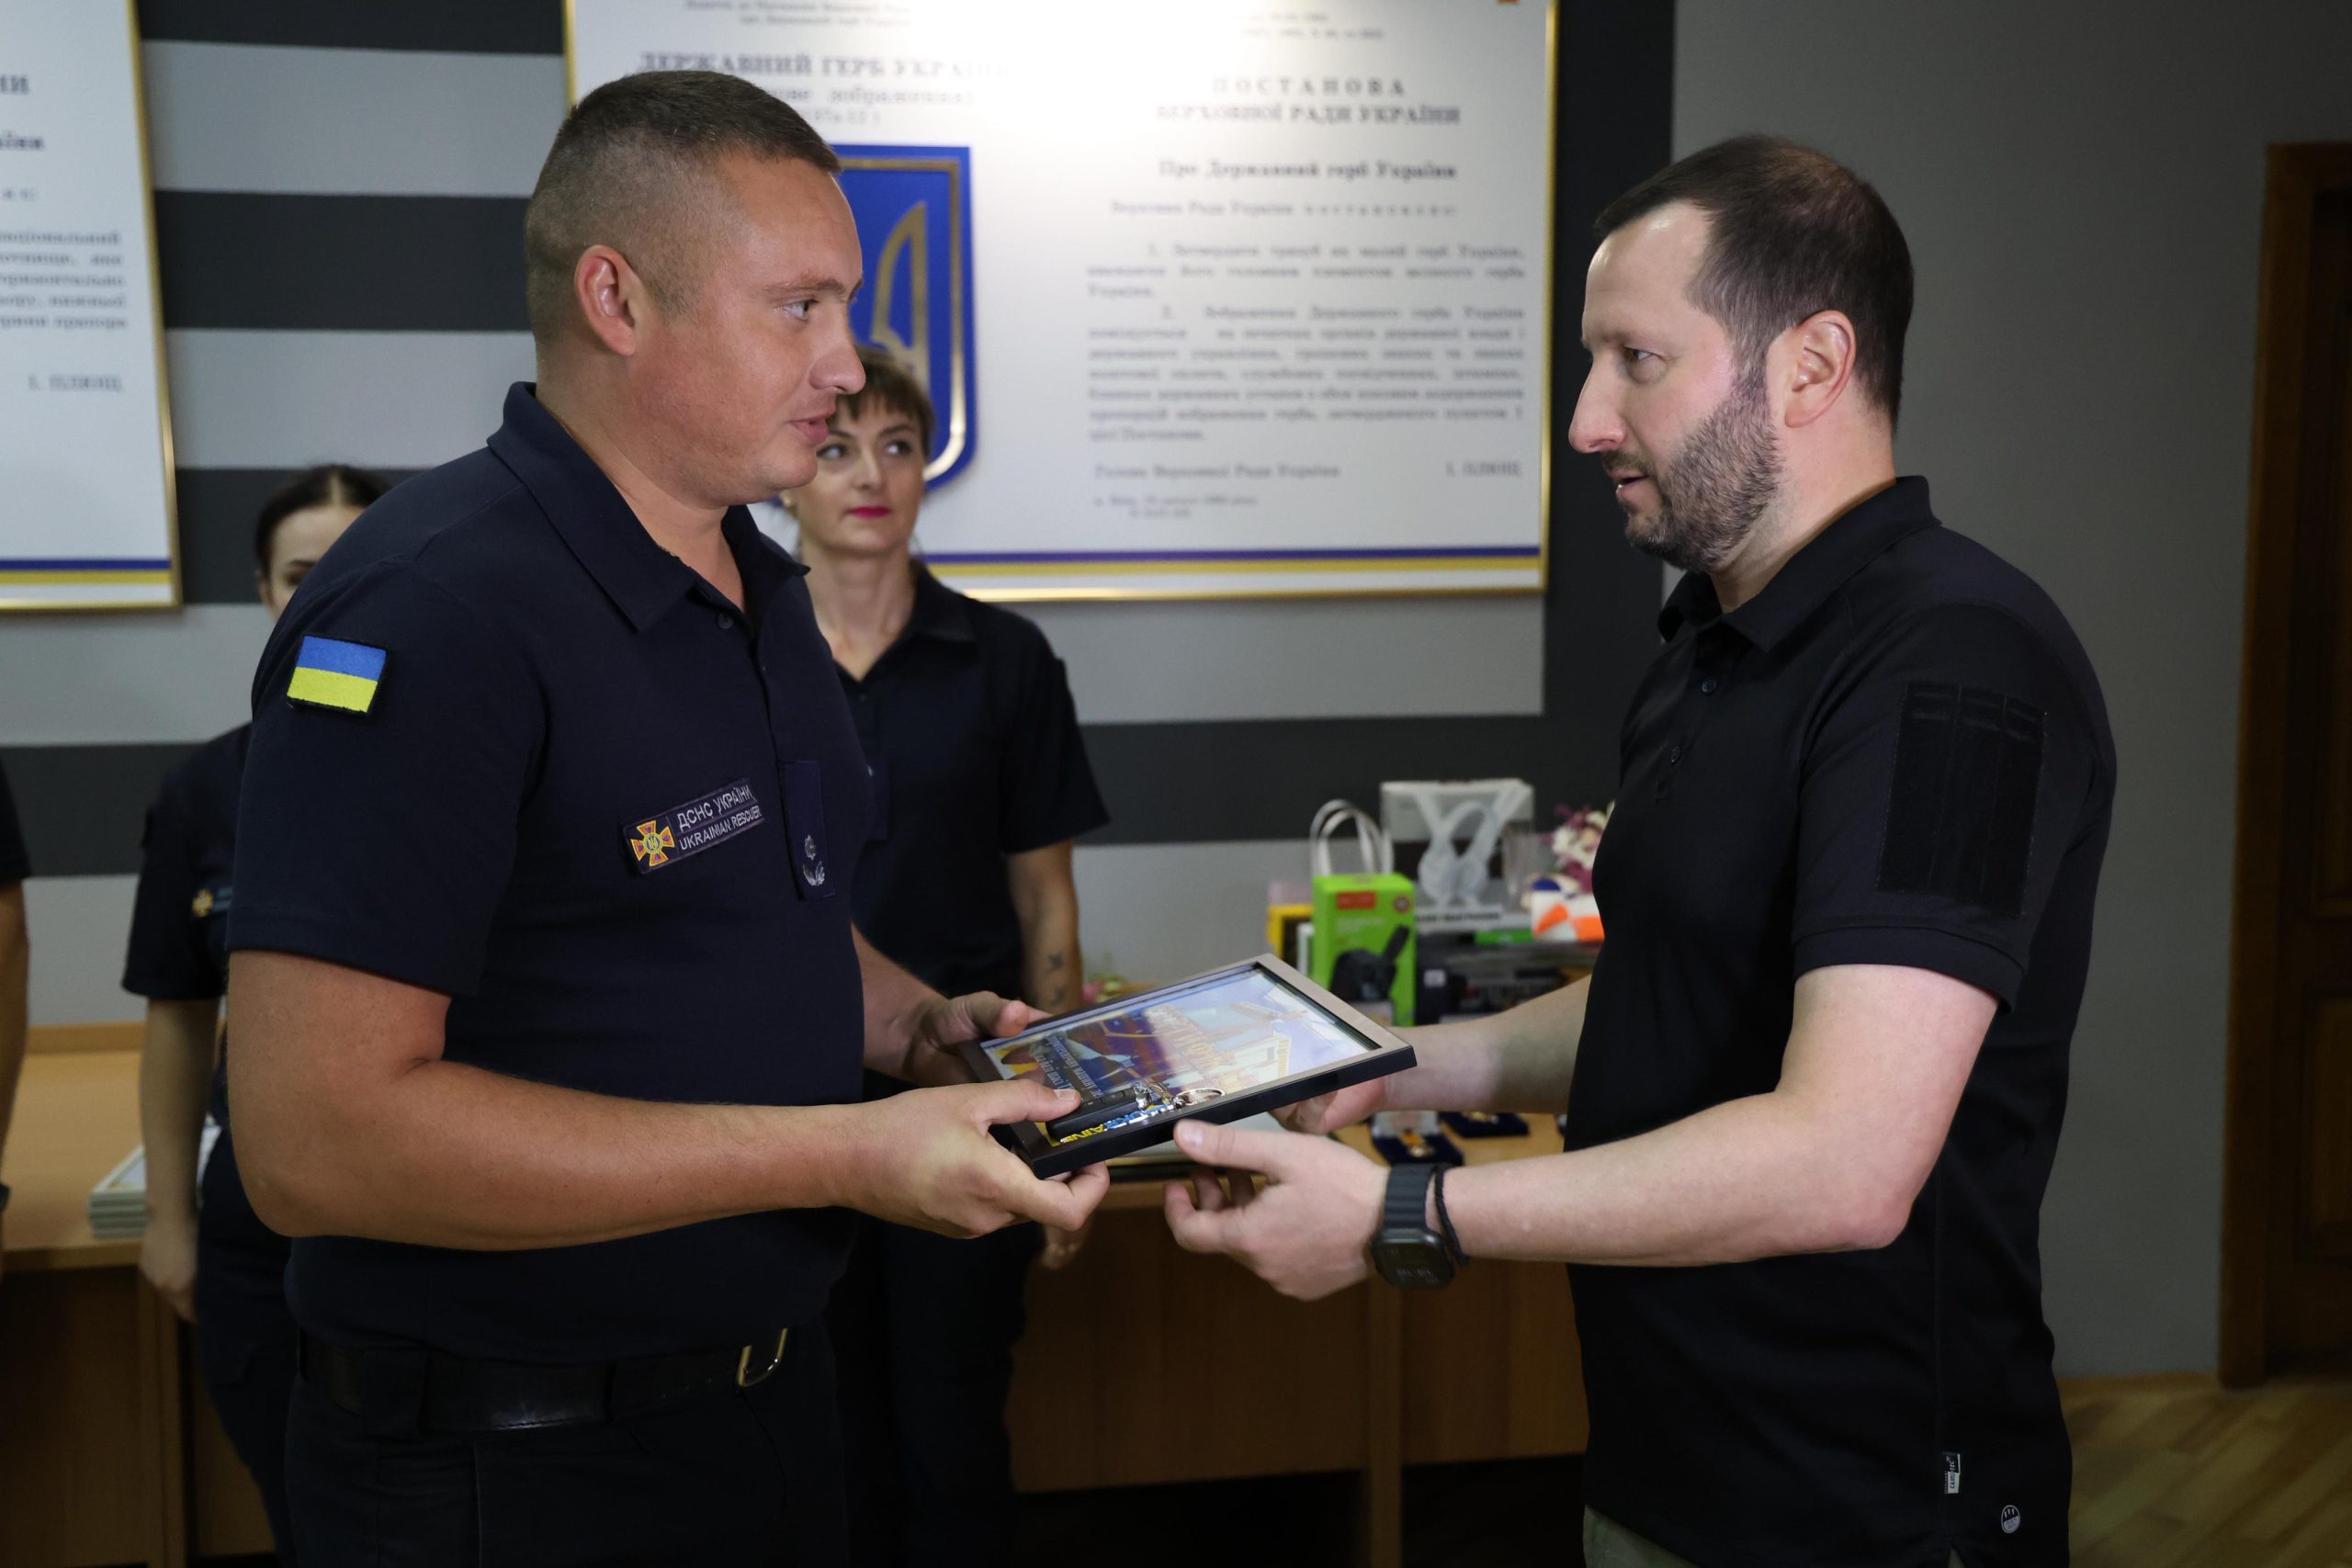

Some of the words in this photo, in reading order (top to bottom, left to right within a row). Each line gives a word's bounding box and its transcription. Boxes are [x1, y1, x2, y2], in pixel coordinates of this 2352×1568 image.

[1290, 106, 1352, 124] РАДИ
[1360, 105, 1461, 124] УКРАЇНИ
[1208, 160, 1320, 180] Державний
[1376, 163, 1459, 182] України
[677, 802, 713, 831] ДСНС
[680, 820, 732, 851] UKRAINIAN
[731, 805, 762, 827] RESCUER
